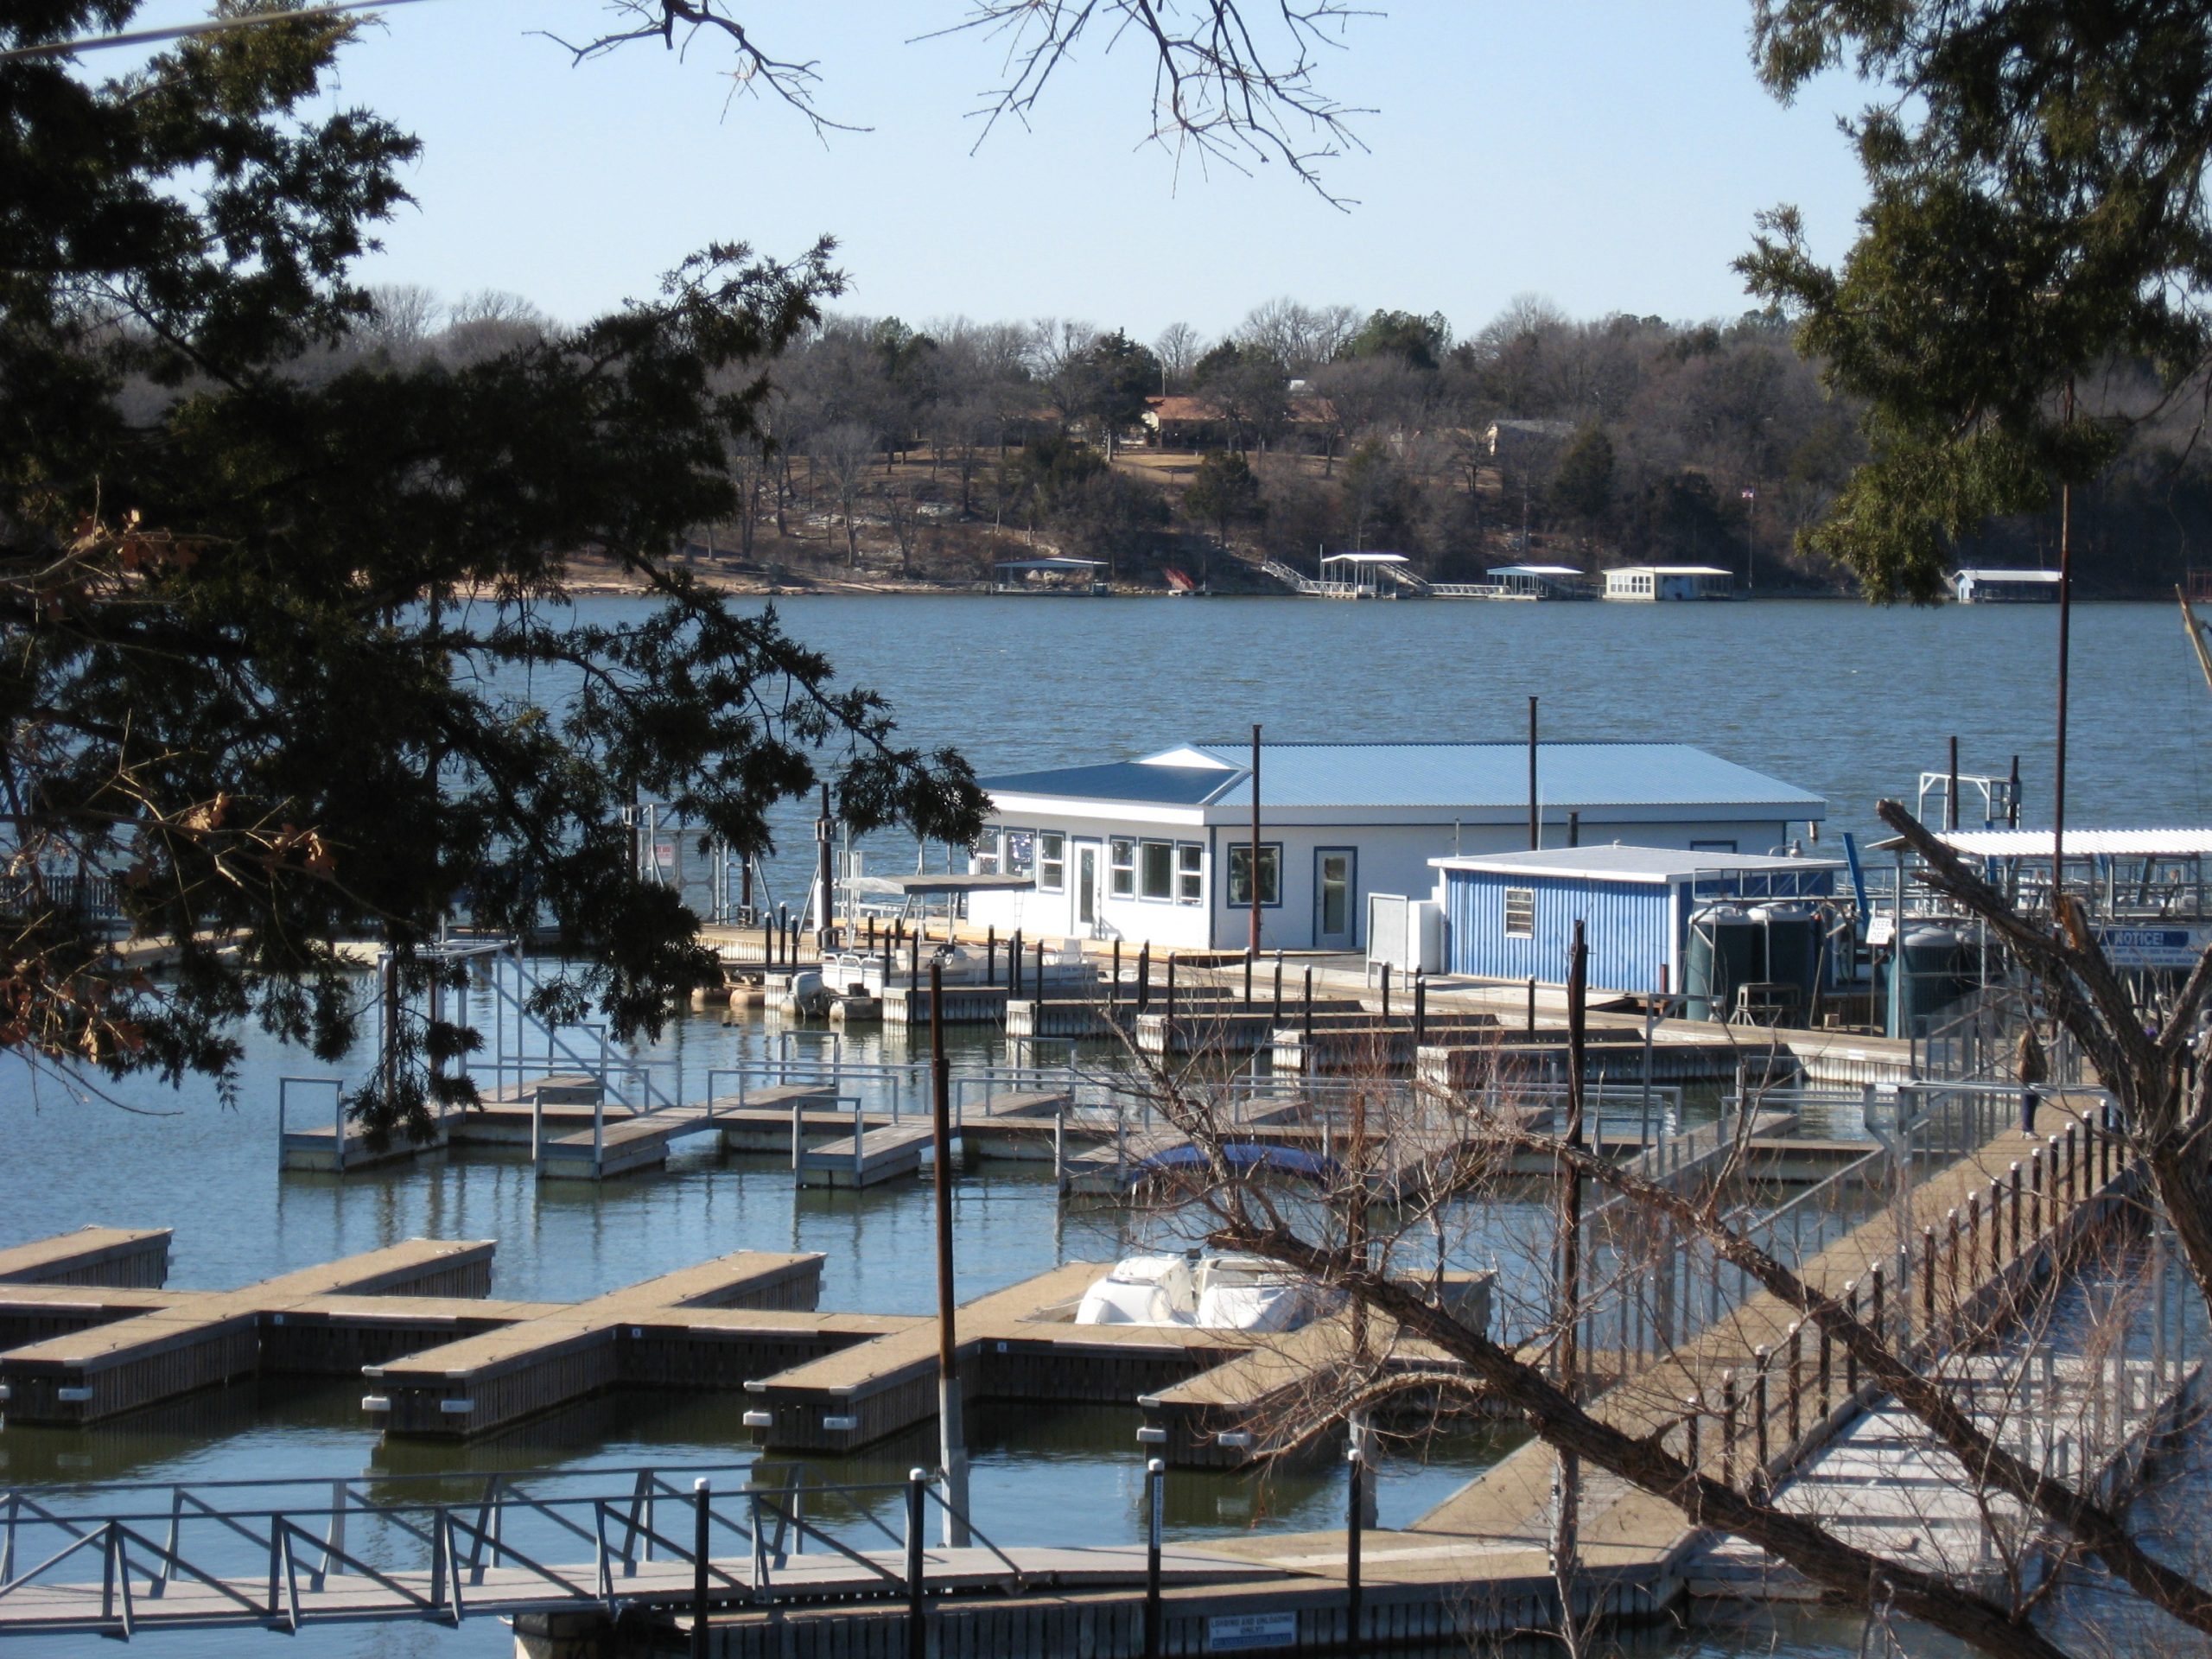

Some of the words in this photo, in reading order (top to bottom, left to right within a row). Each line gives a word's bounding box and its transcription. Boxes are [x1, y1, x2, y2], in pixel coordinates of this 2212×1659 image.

[1872, 920, 1891, 930] KEEP
[1871, 931, 1886, 942] OFF
[2113, 931, 2164, 946] NOTICE!
